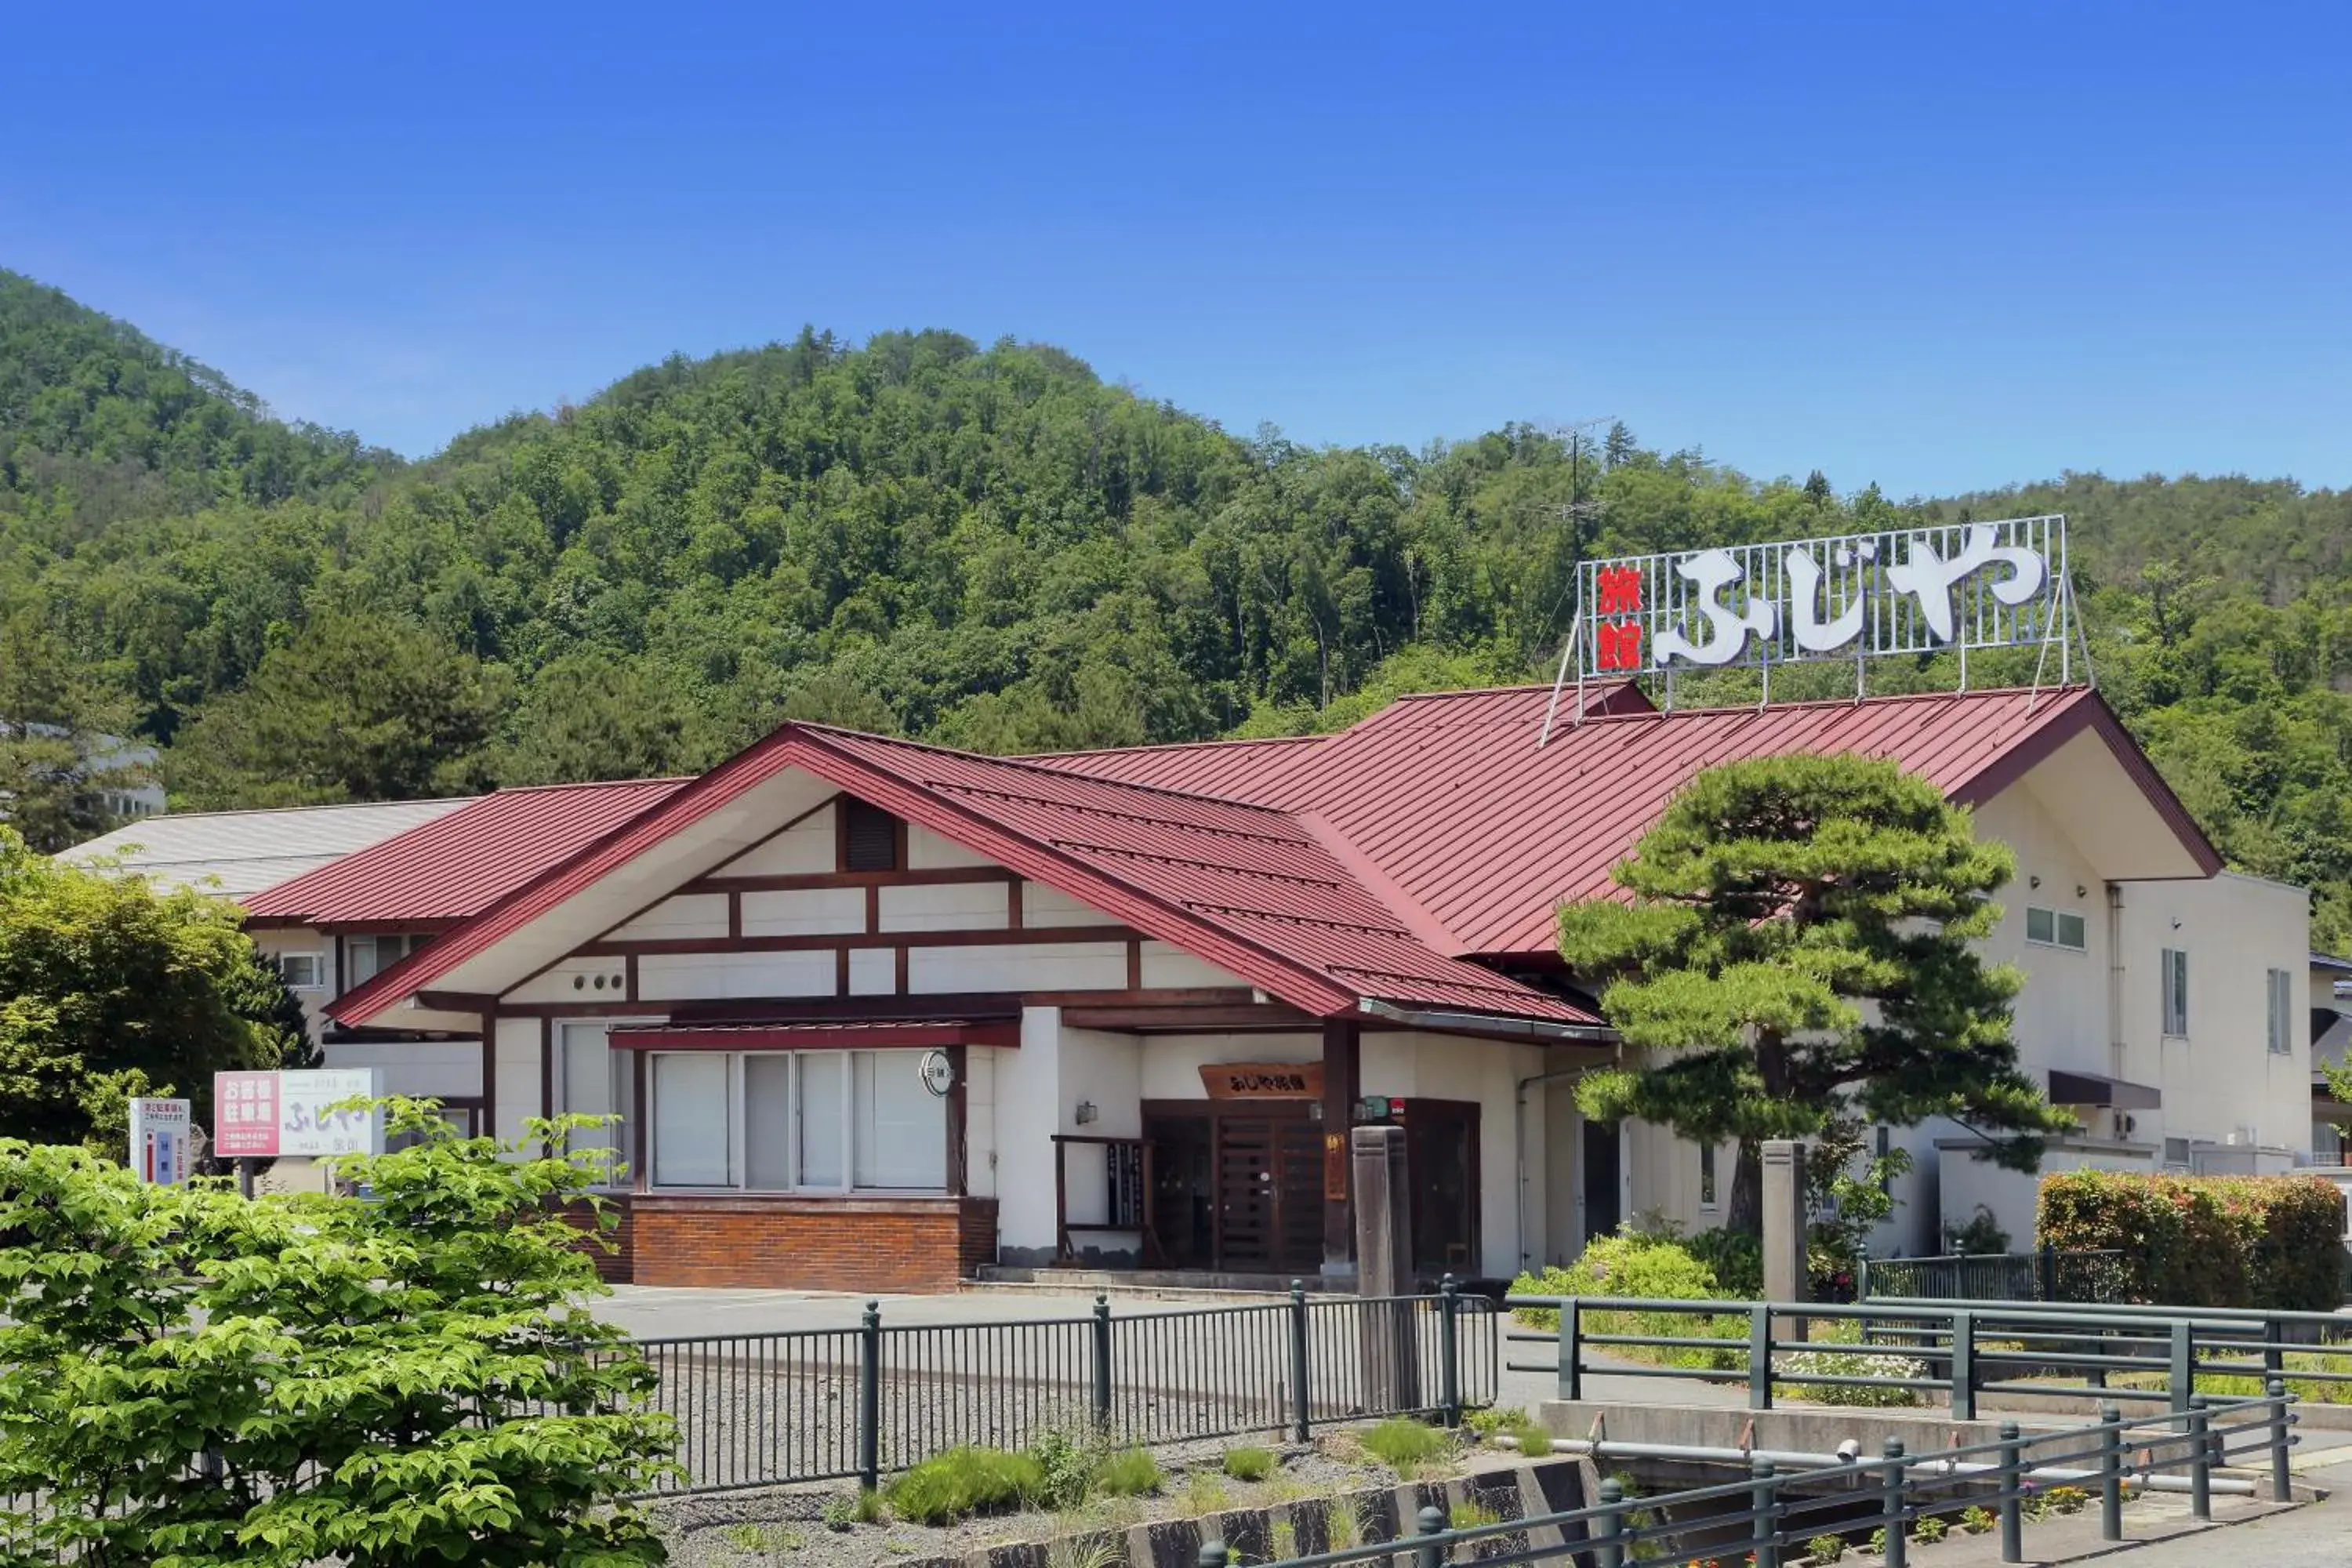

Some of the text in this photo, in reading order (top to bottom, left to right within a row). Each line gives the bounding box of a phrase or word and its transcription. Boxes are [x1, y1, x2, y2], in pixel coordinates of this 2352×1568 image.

[1596, 565, 1642, 670] 旅館
[1652, 524, 2046, 666] ふじや
